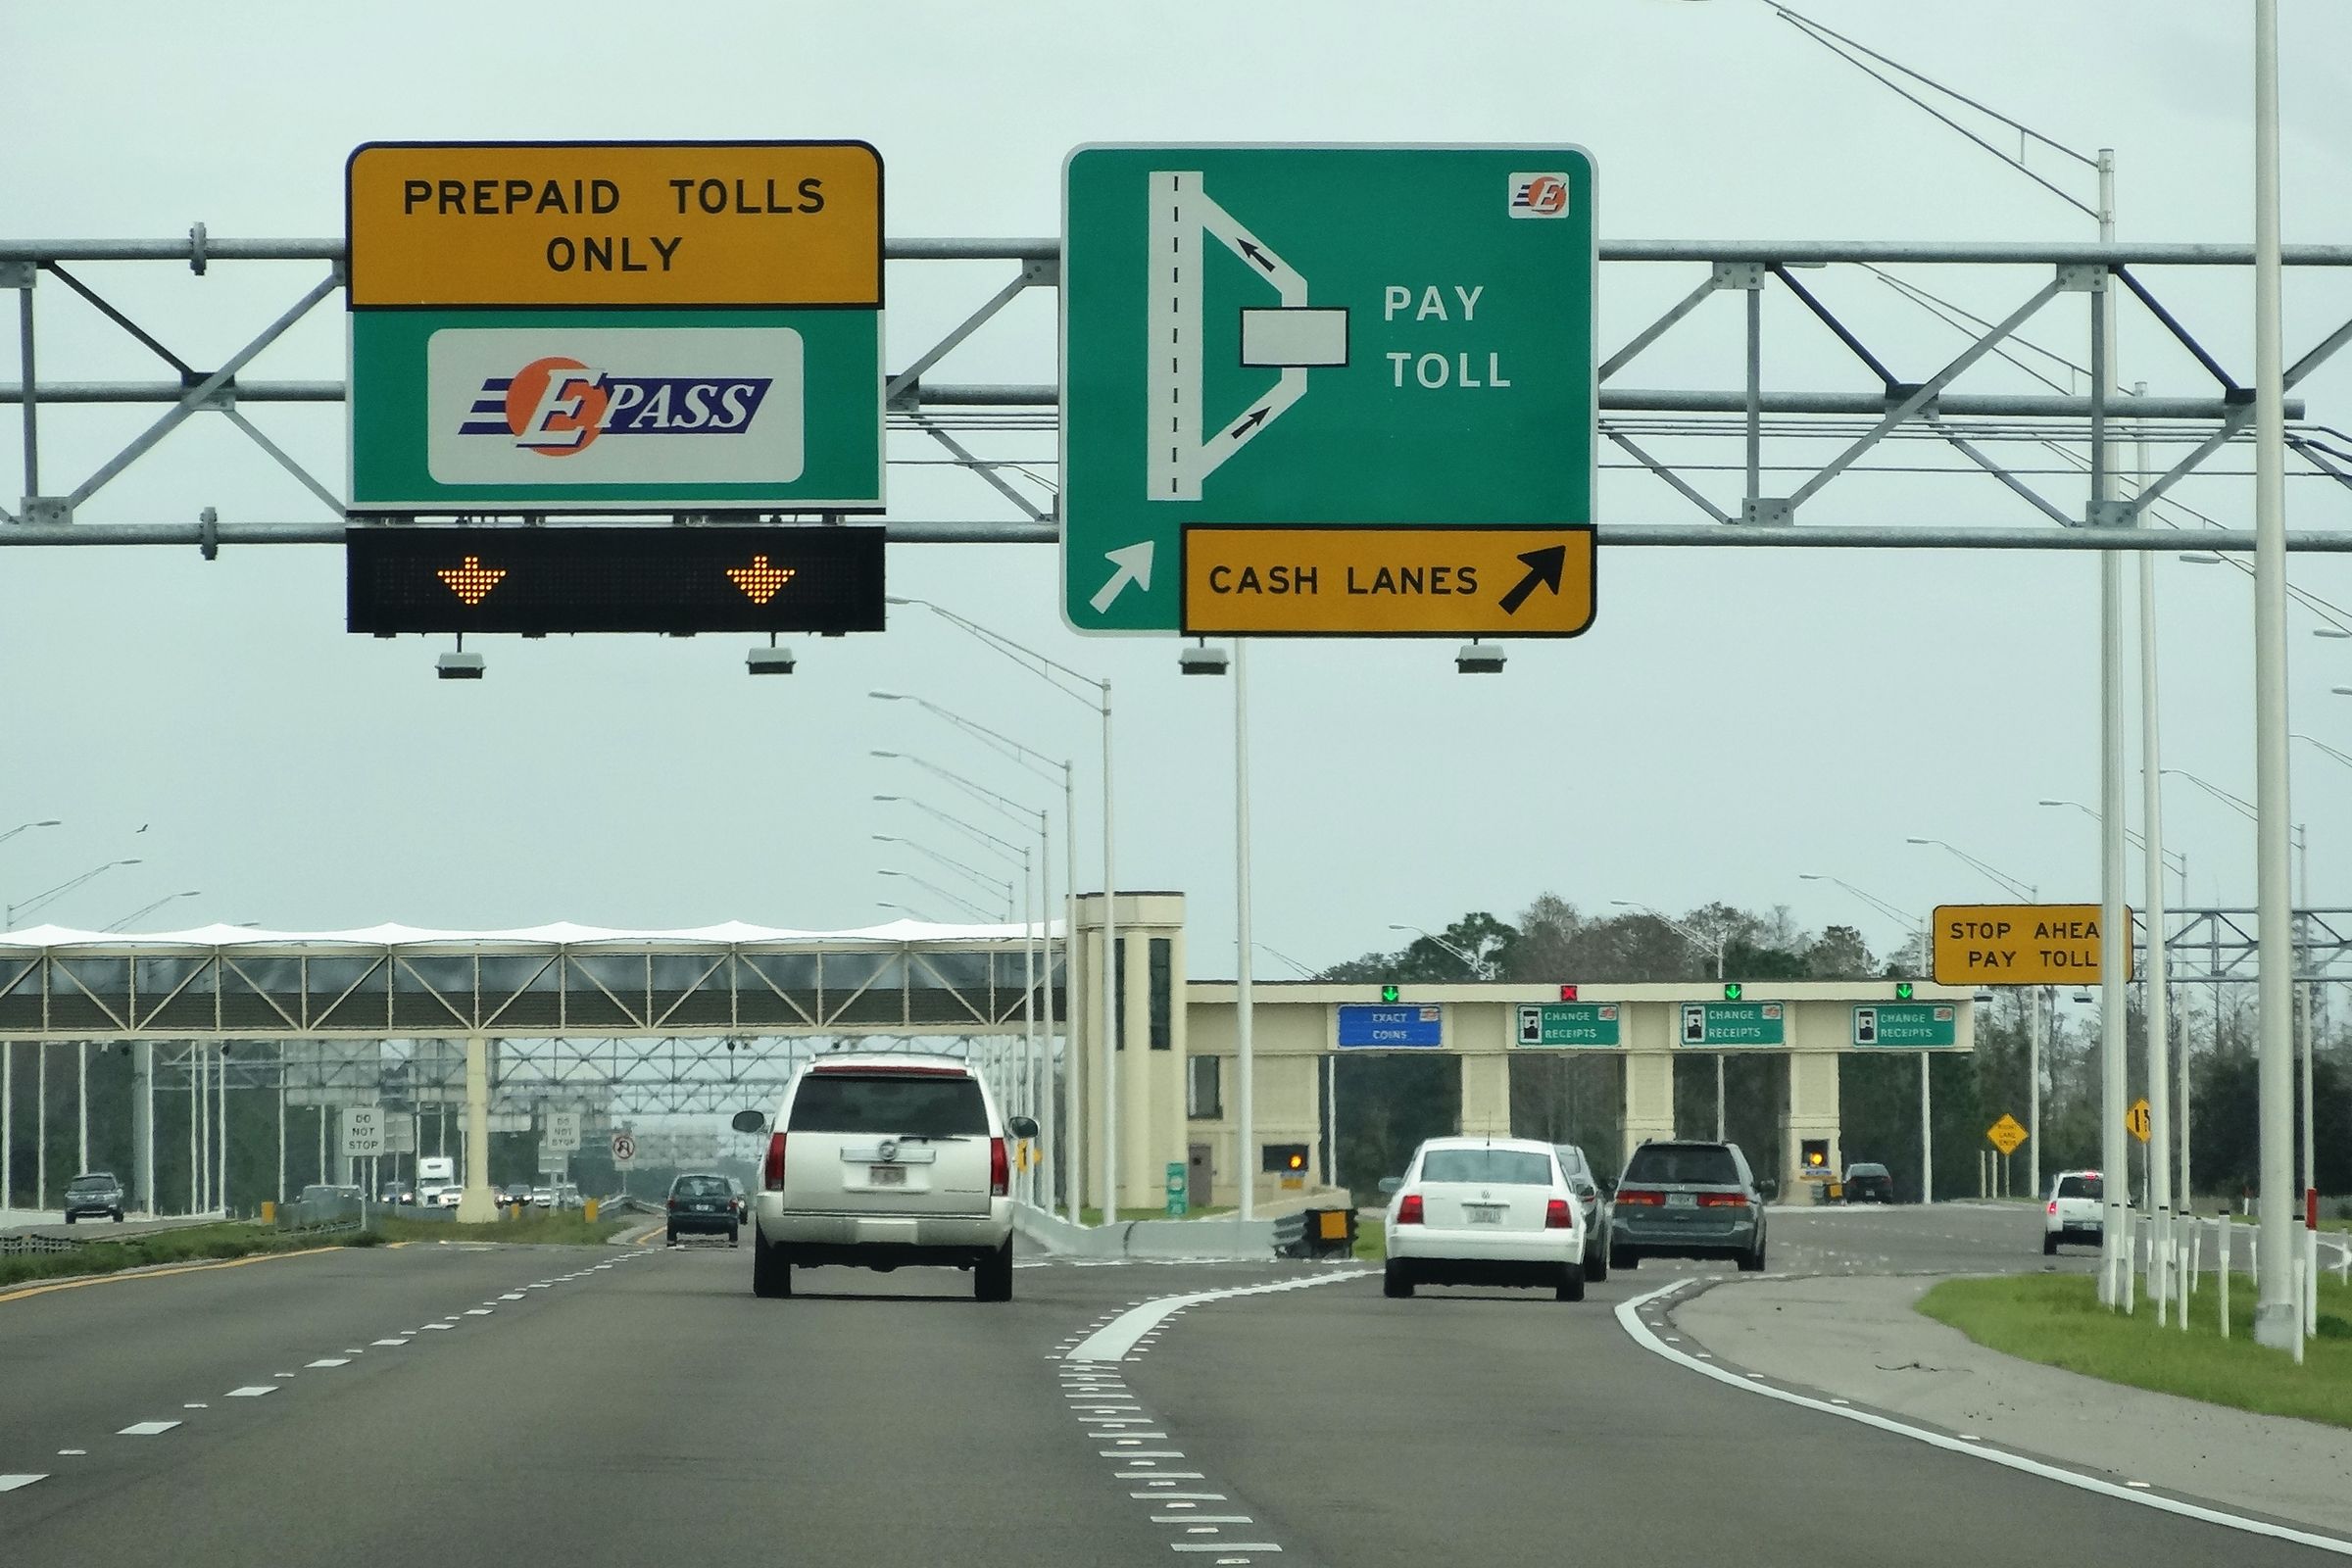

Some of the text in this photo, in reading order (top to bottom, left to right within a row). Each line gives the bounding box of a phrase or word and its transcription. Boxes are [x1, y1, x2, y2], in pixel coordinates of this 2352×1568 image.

[404, 177, 825, 216] PREPAID TOLLS
[546, 236, 683, 272] ONLY
[1384, 285, 1485, 321] PAY
[1386, 352, 1511, 389] TOLL
[1208, 564, 1478, 595] CASH LANES
[1949, 921, 2100, 940] STOP AHEA
[1968, 950, 2098, 968] PAY TOLL
[1372, 1012, 1407, 1023] EXACT
[1544, 1011, 1591, 1021] CHANGE
[1708, 1009, 1754, 1020] CHANGE
[1881, 1013, 1926, 1024] CHANGE
[1372, 1030, 1407, 1040] COINS
[1544, 1028, 1597, 1039] RECEIPTS
[1708, 1027, 1761, 1039] RECEIPTS
[1881, 1028, 1933, 1038] RECEIPTS
[356, 1114, 371, 1124] DO
[352, 1127, 374, 1137] NOT
[348, 1141, 378, 1151] STOP
